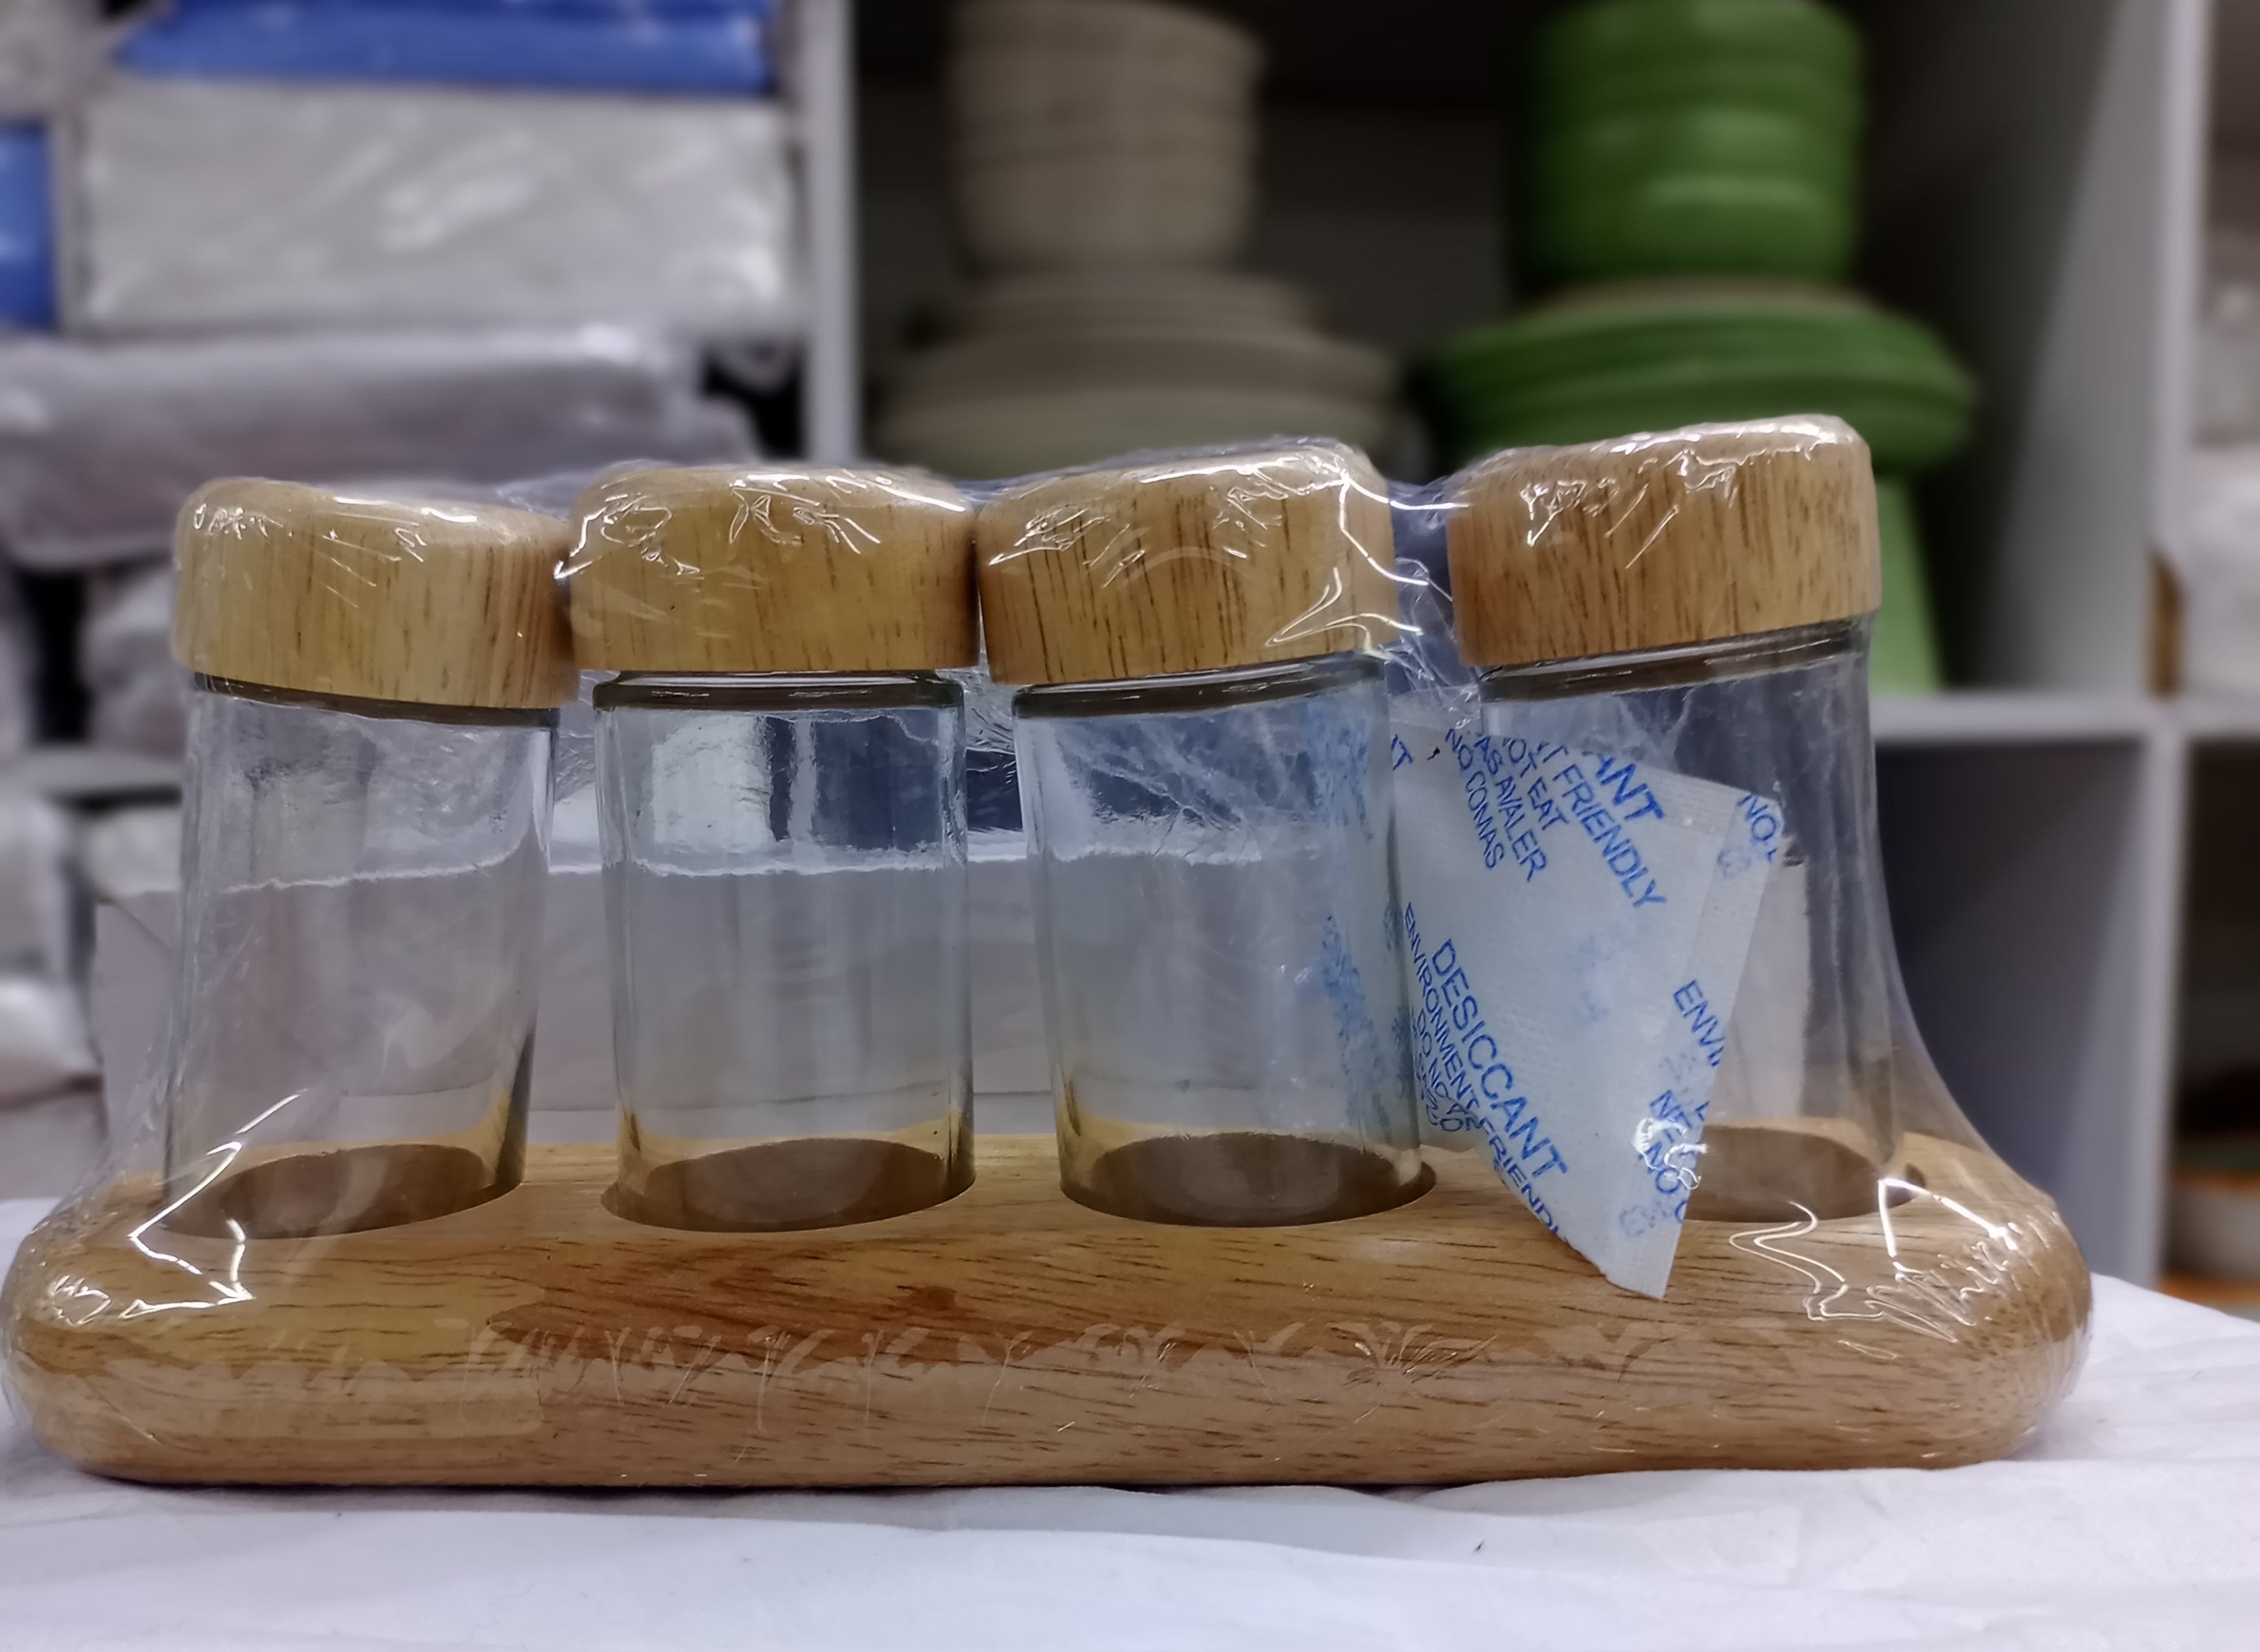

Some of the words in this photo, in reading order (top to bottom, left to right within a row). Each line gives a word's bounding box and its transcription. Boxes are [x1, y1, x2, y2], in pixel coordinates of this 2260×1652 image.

[1445, 728, 1473, 770] NO
[1465, 770, 1504, 869] COMAS
[1474, 732, 1503, 775] AS
[1496, 776, 1548, 882] AVALER
[1503, 738, 1537, 778] OT
[1528, 776, 1569, 831] EAT
[1552, 763, 1667, 908] FRIENDLY
[1405, 903, 1480, 1112] ENVIRONMENT
[1431, 939, 1567, 1179] DESICCANT
